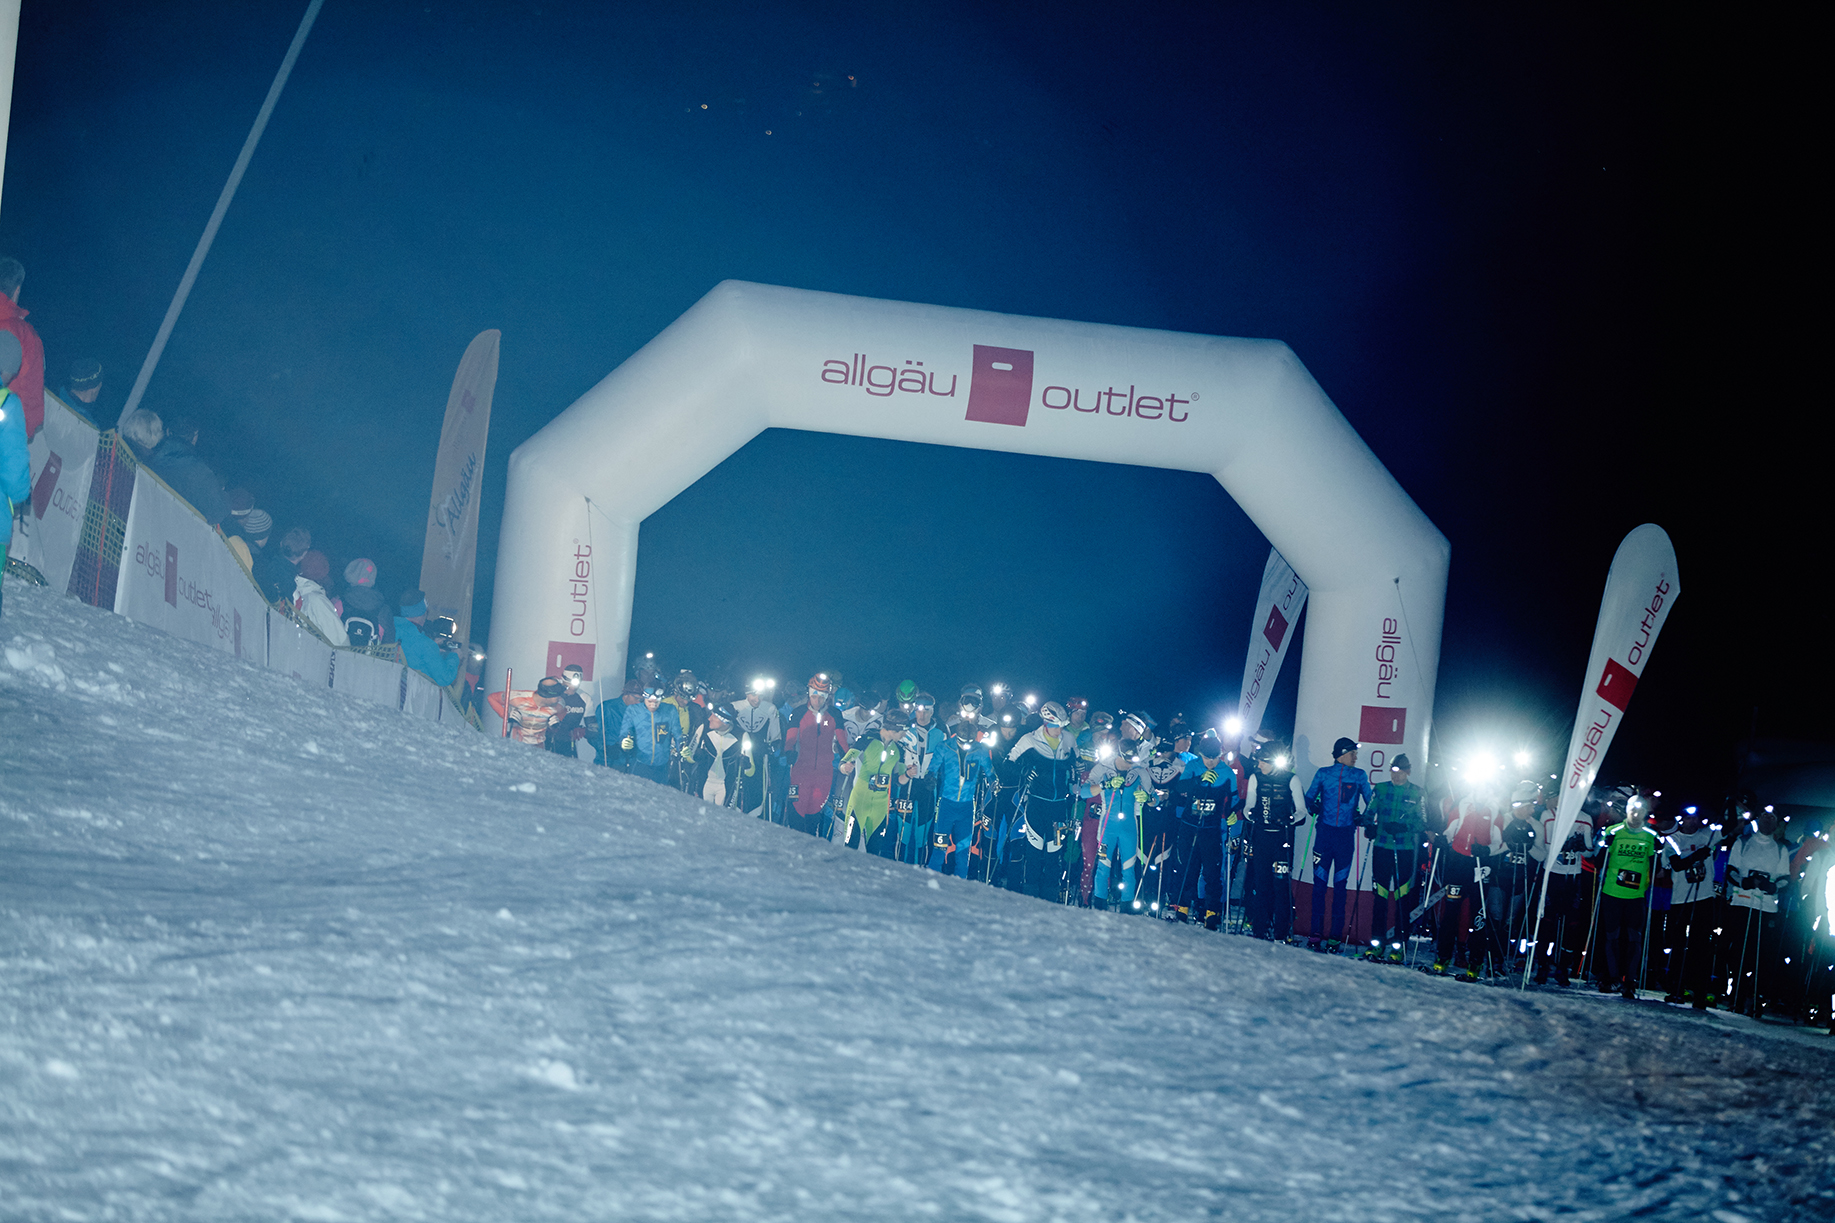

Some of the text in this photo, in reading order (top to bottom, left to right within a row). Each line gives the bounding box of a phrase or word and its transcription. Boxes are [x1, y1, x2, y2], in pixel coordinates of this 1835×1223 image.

[820, 353, 957, 397] allgäu
[1243, 648, 1271, 720] allgäu
[1375, 617, 1402, 699] allgäu
[1569, 708, 1613, 789] allgäu
[937, 836, 943, 844] 6
[1450, 888, 1461, 896] 87
